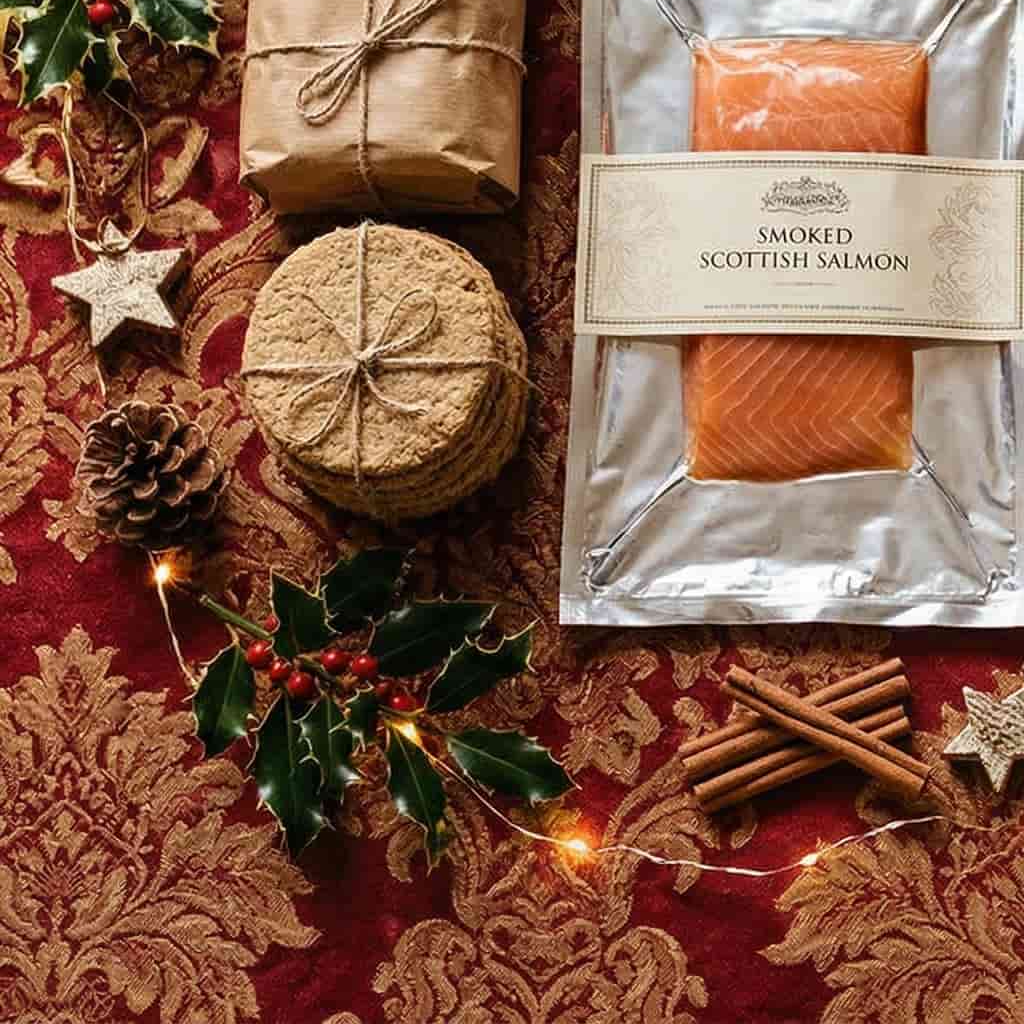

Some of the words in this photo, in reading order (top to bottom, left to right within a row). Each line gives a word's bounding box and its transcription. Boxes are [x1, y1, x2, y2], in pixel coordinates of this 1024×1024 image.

[756, 226, 853, 245] SMOKED
[699, 251, 809, 270] SCOTTISH
[815, 252, 910, 272] SALMON
